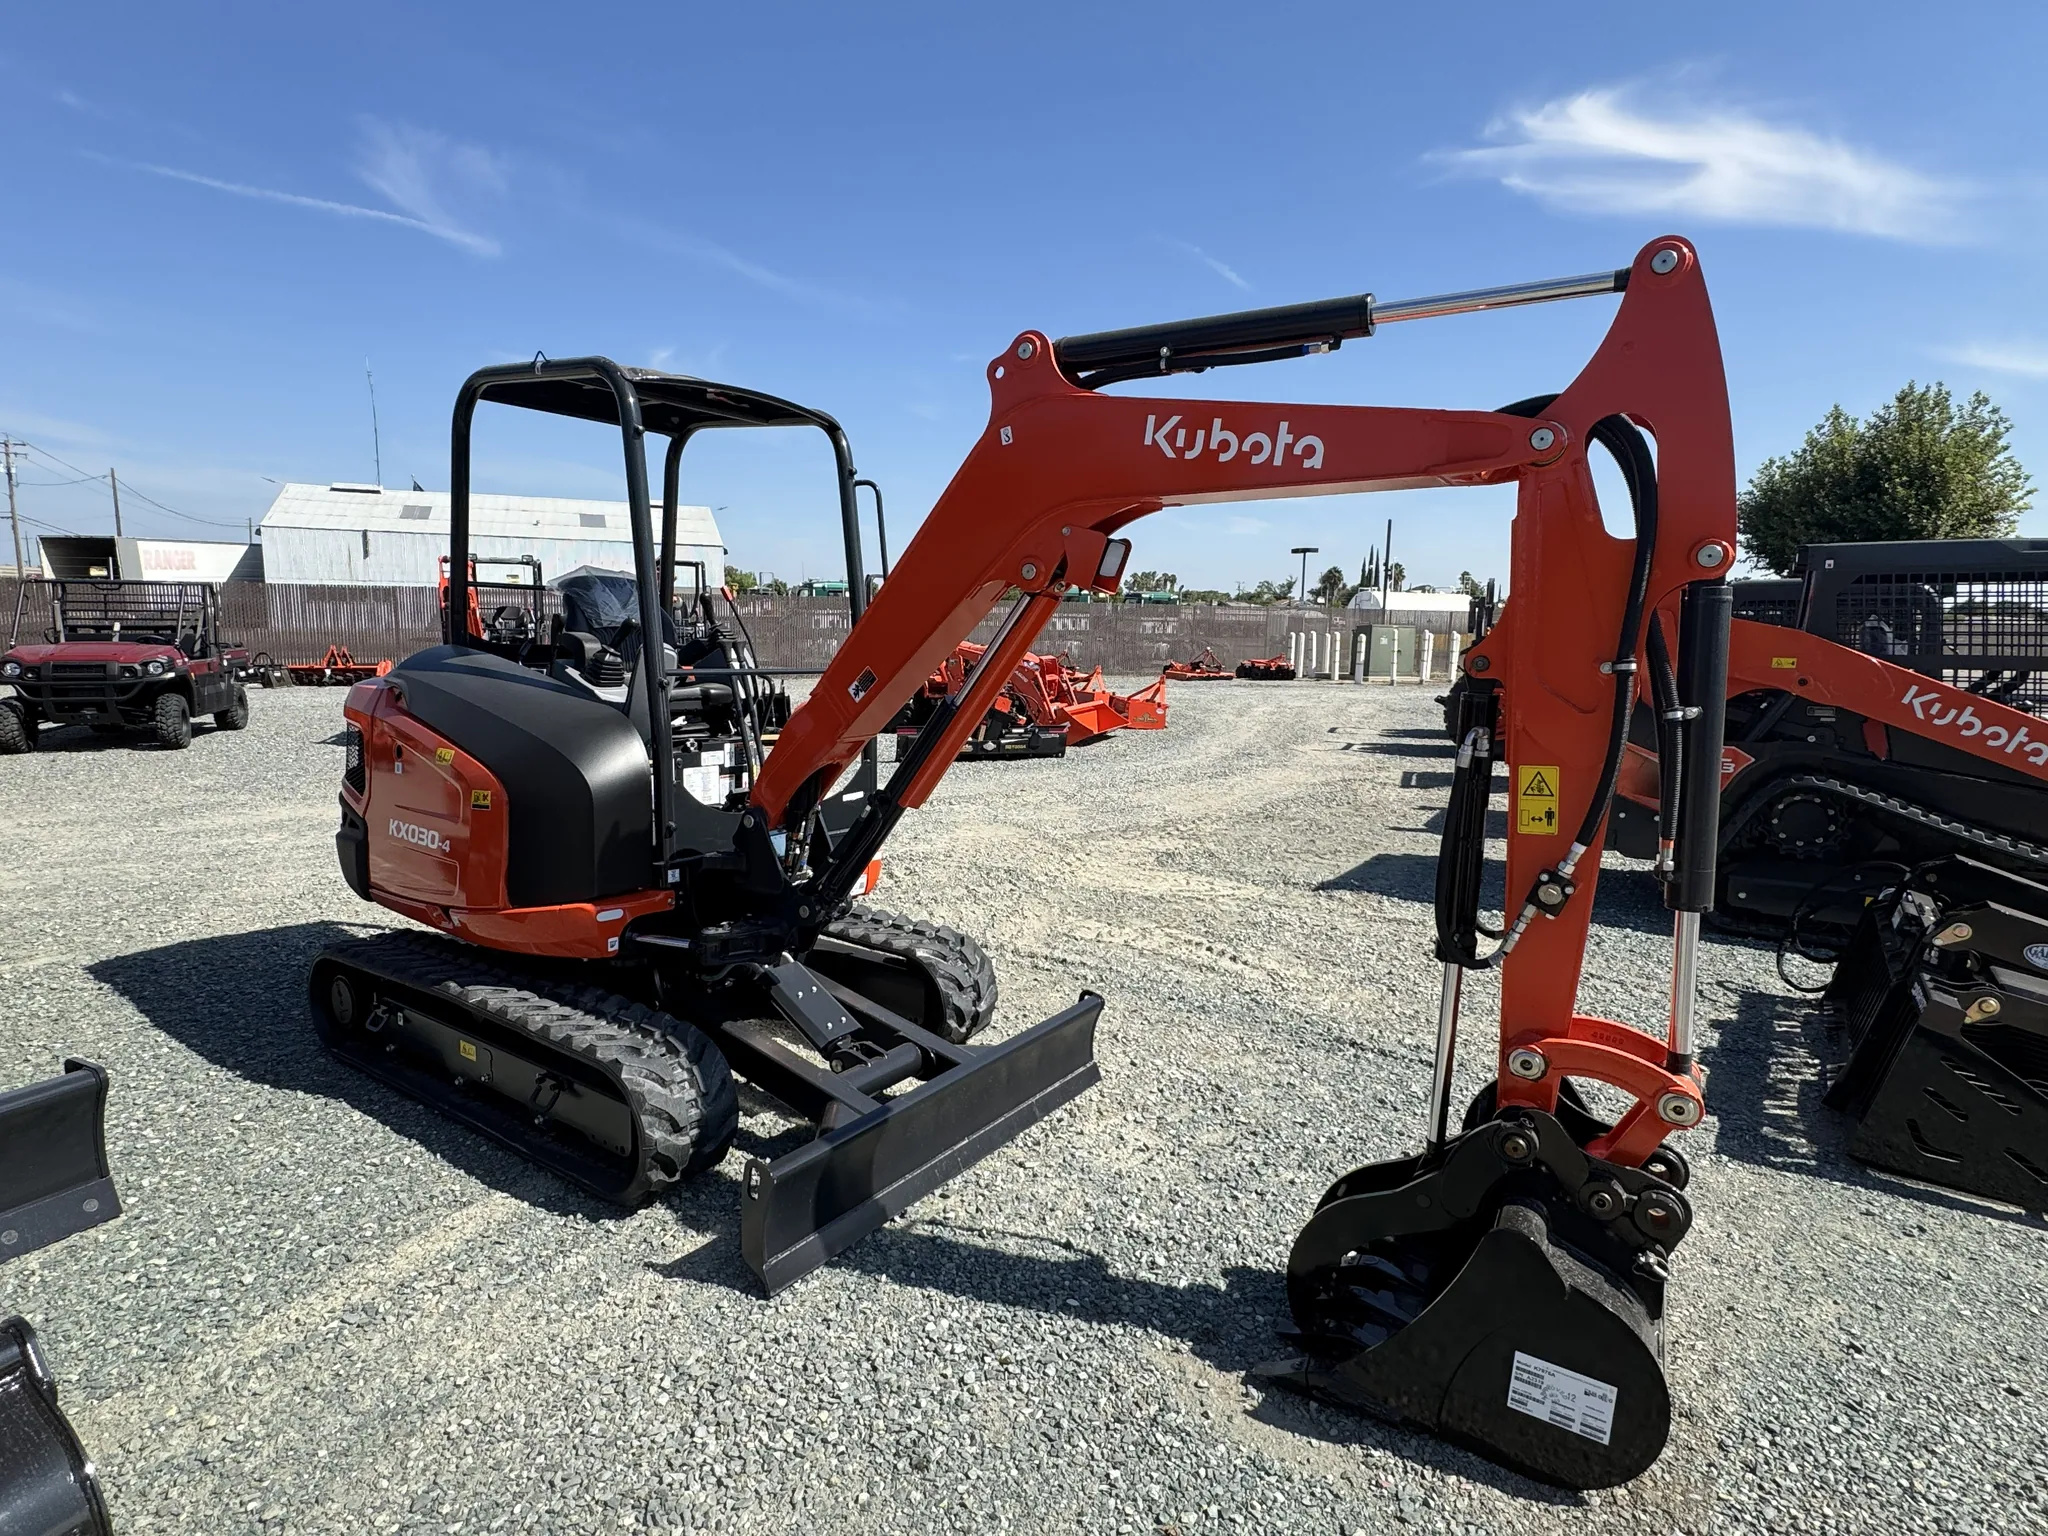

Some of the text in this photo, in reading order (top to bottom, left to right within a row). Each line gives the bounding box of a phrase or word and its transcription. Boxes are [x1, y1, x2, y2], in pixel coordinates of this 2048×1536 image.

[1144, 414, 1325, 469] Kubota
[142, 549, 197, 571] RANGER
[1901, 684, 2048, 766] Kubota
[389, 818, 451, 853] KX030-4
